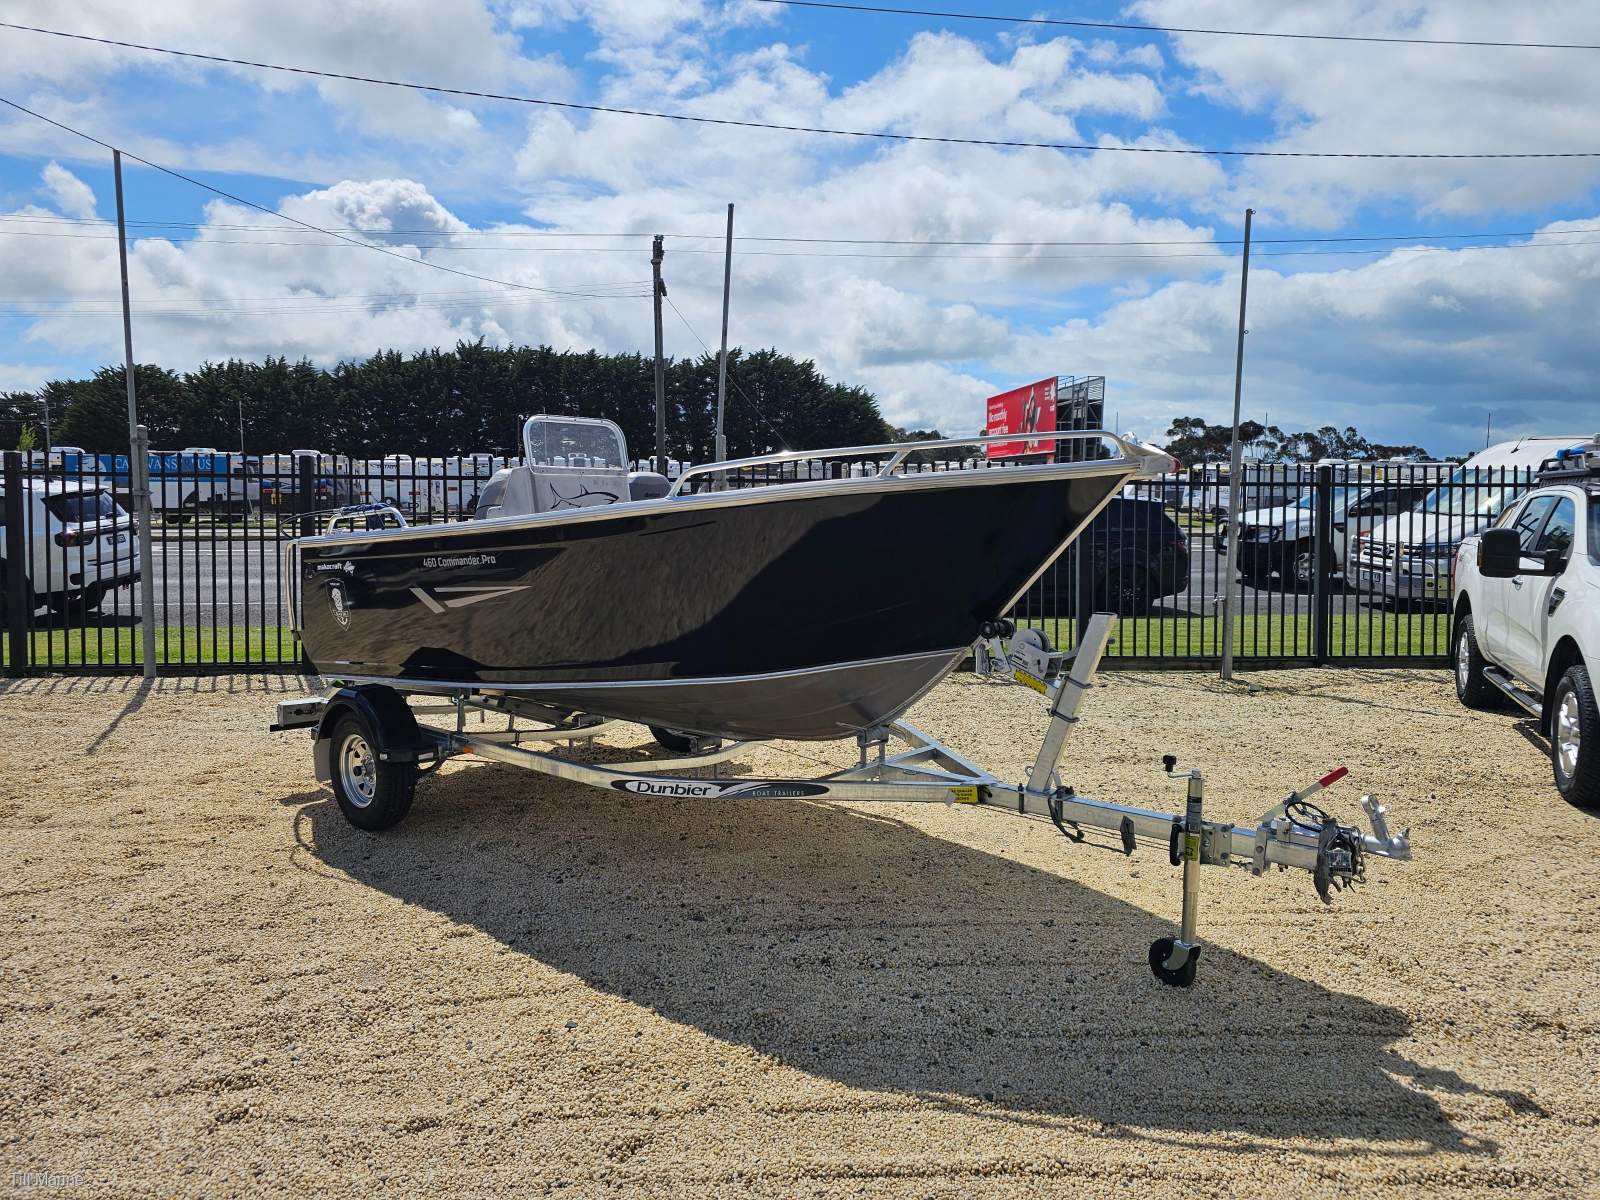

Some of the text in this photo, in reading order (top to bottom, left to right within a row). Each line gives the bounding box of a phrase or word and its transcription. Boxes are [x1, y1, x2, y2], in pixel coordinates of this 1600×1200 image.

[423, 554, 496, 568] 460 Commander Pro
[636, 781, 711, 796] Dunbier
